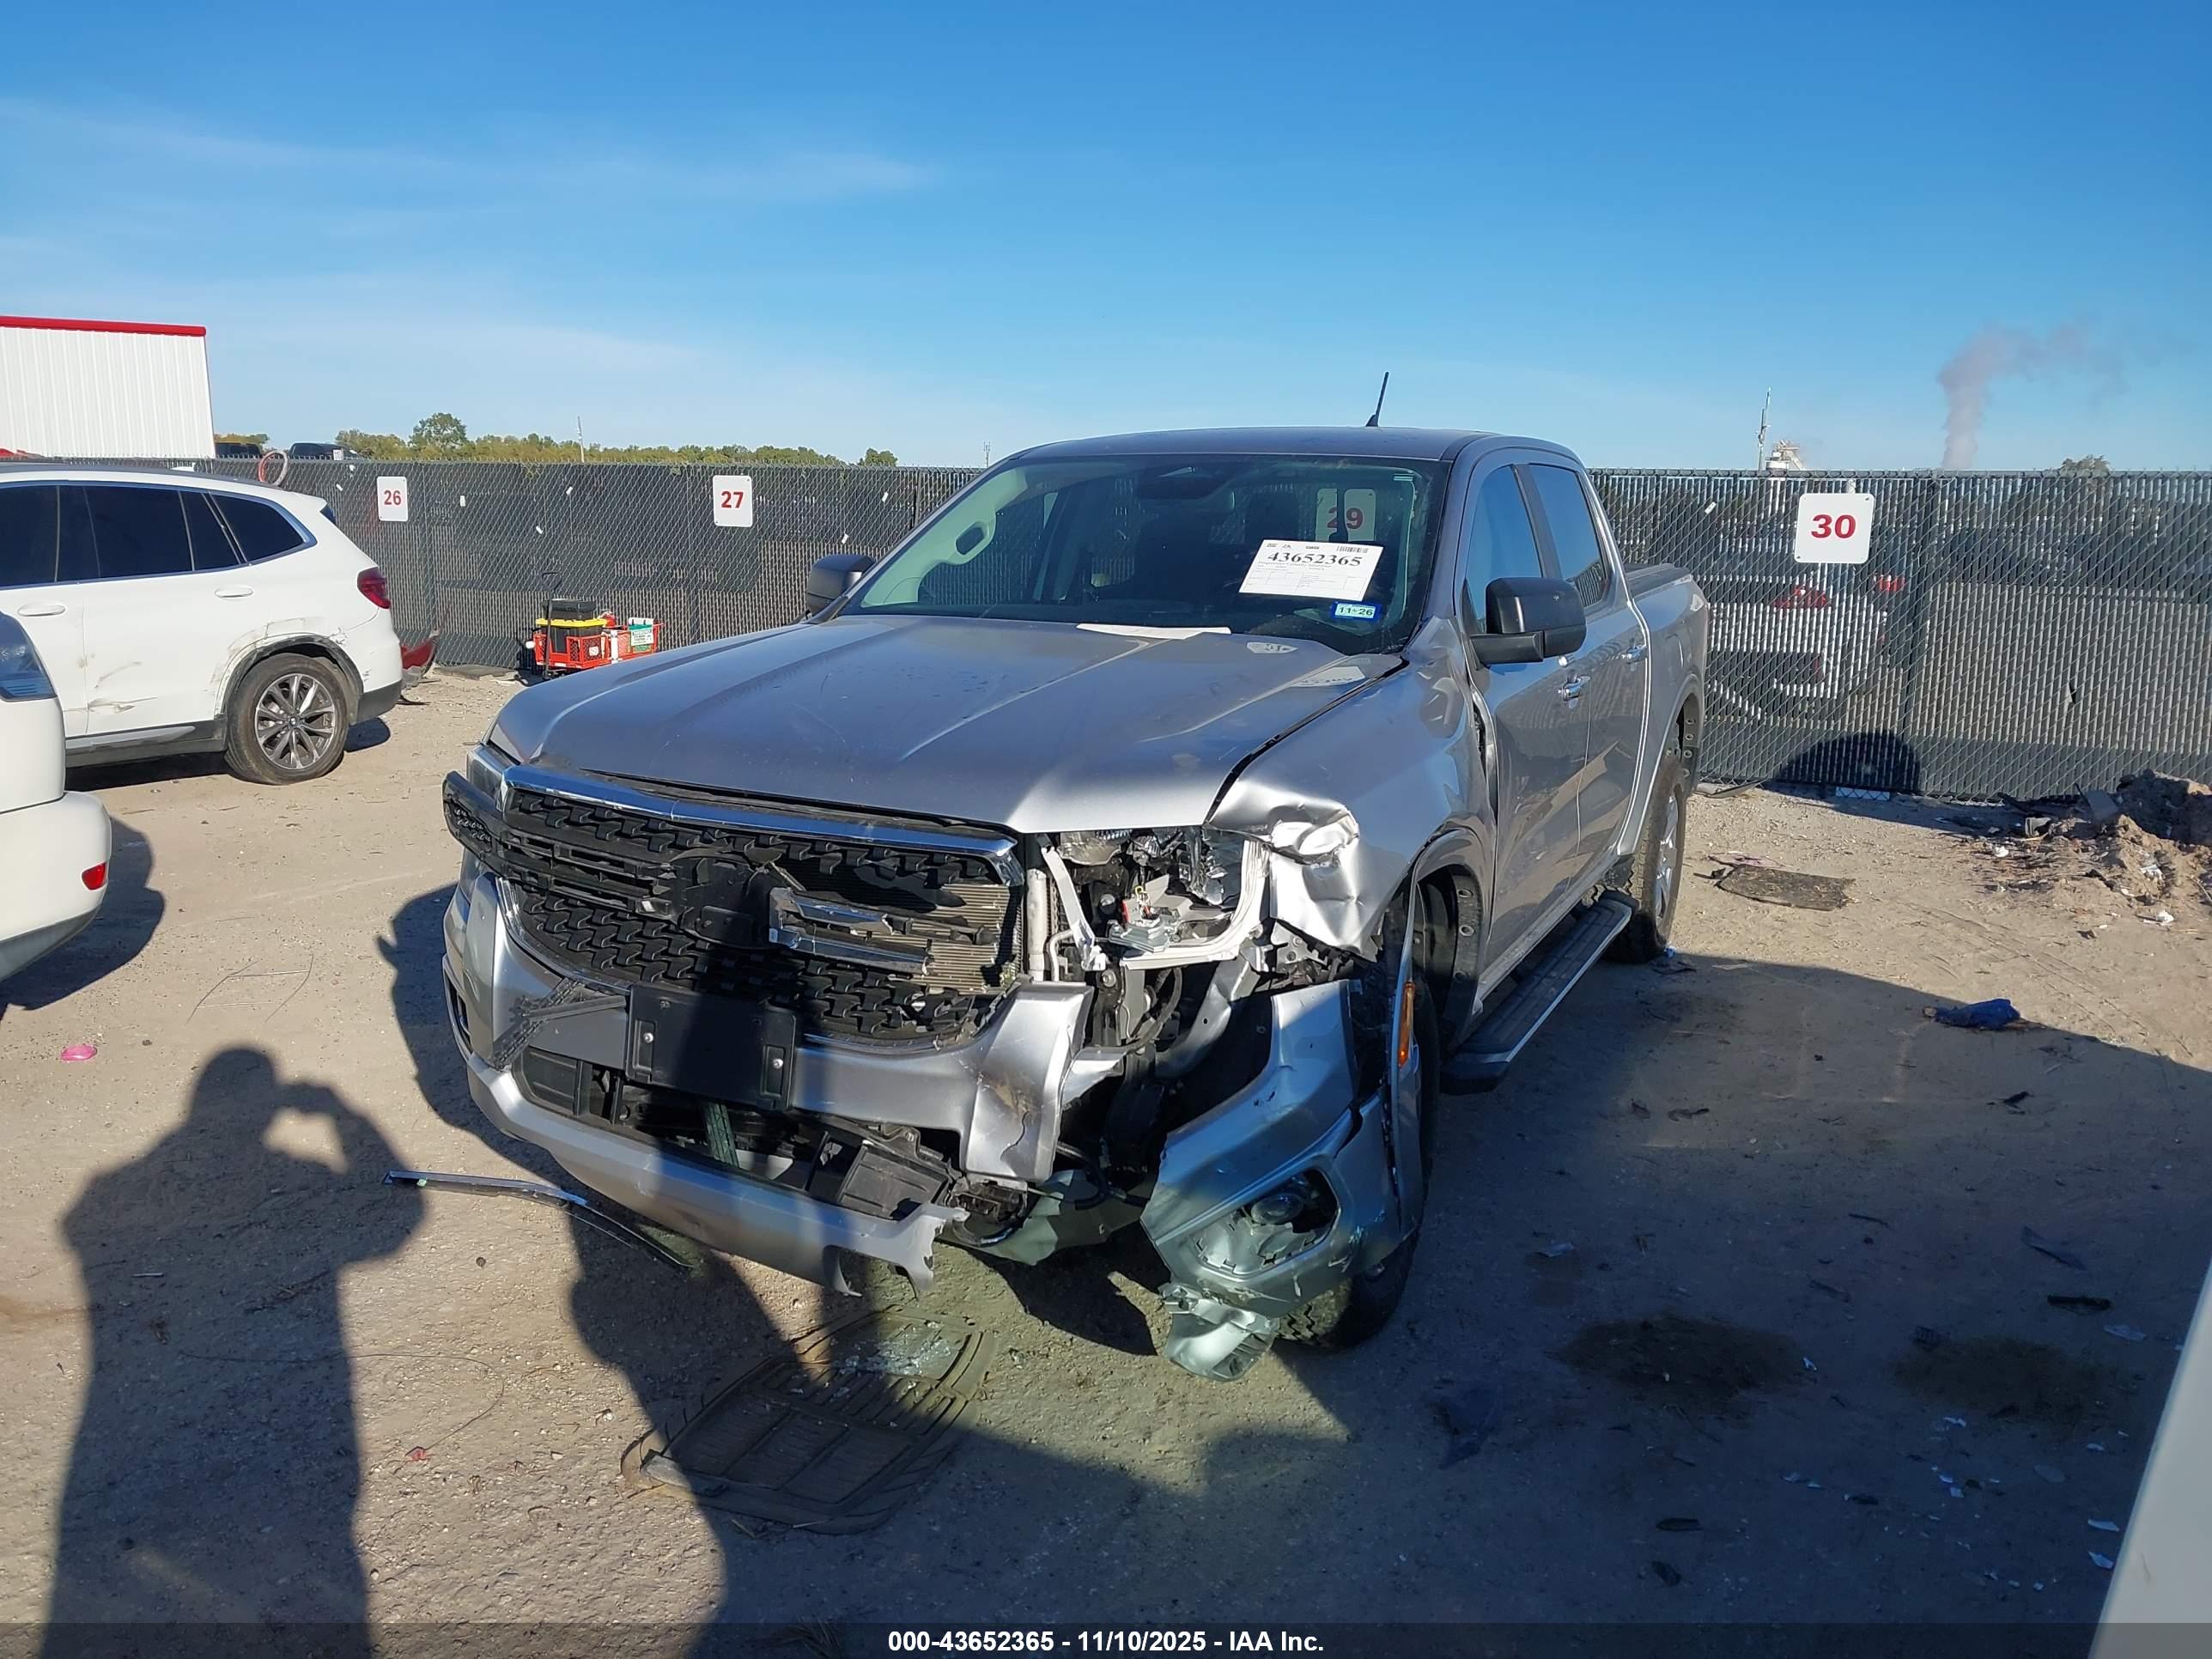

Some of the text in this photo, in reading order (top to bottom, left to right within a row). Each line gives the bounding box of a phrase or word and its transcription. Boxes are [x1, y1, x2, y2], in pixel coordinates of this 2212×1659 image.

[384, 489, 402, 506] 26
[720, 490, 744, 508] 27
[1327, 507, 1364, 530] 29
[1810, 514, 1856, 539] 30
[1267, 551, 1363, 567] 43652365
